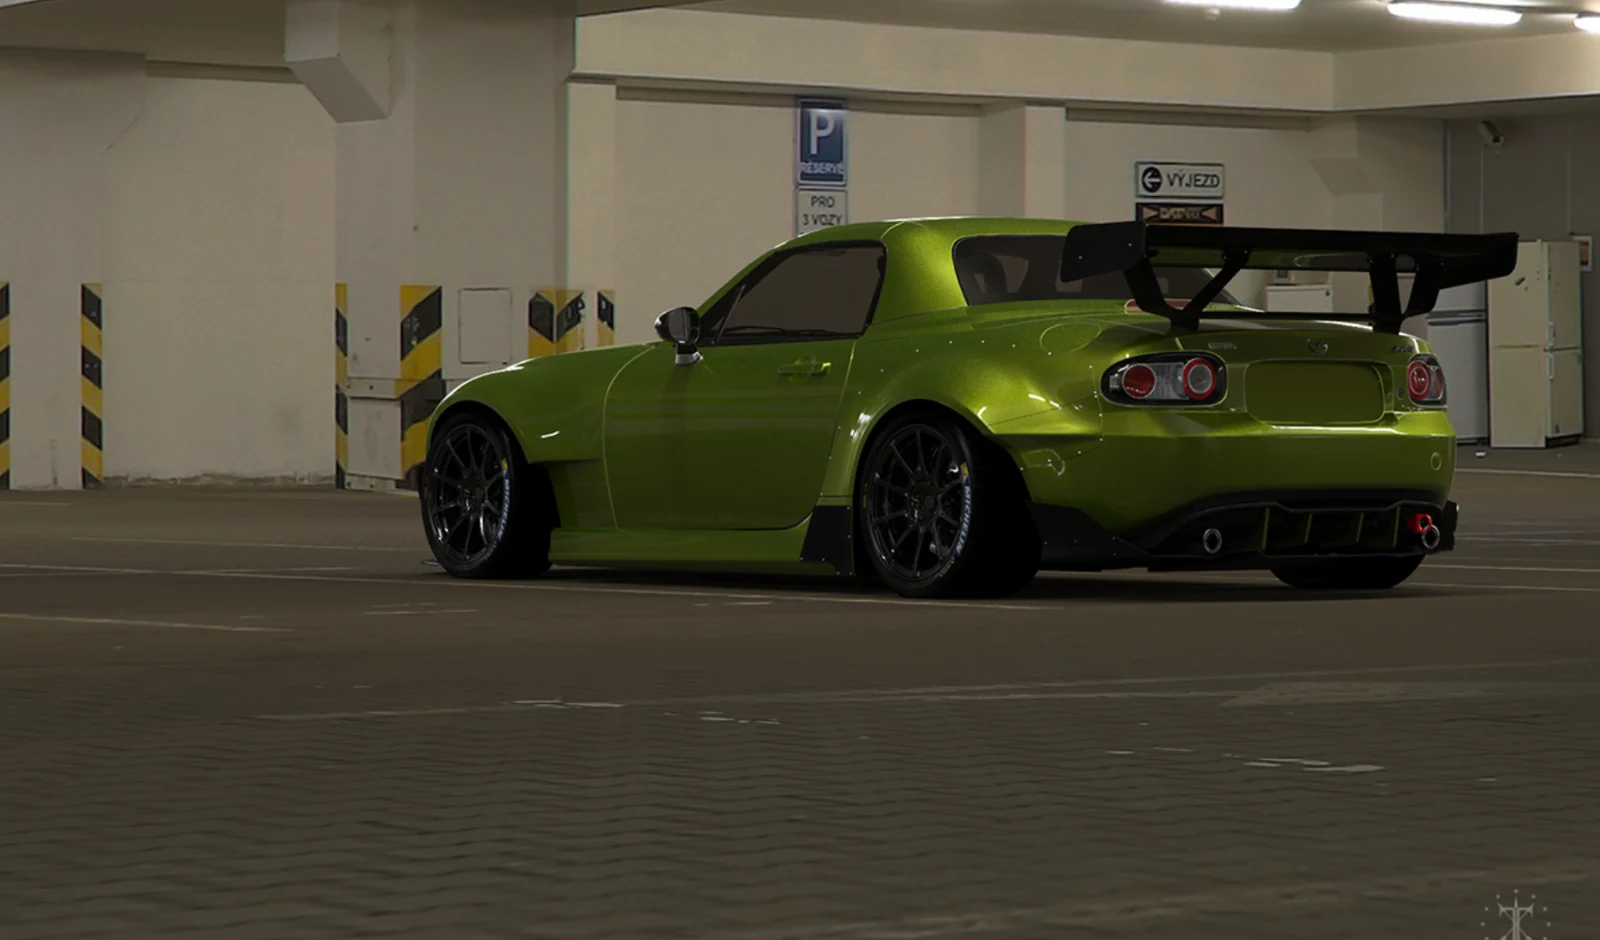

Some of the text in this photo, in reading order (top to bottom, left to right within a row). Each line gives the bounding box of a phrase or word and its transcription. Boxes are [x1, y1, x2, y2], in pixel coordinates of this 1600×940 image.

[809, 109, 835, 155] P
[1166, 168, 1221, 189] VÝJEZD
[811, 195, 835, 208] PRO
[803, 213, 842, 226] 3 VOZY
[955, 486, 972, 554] MICHELIN
